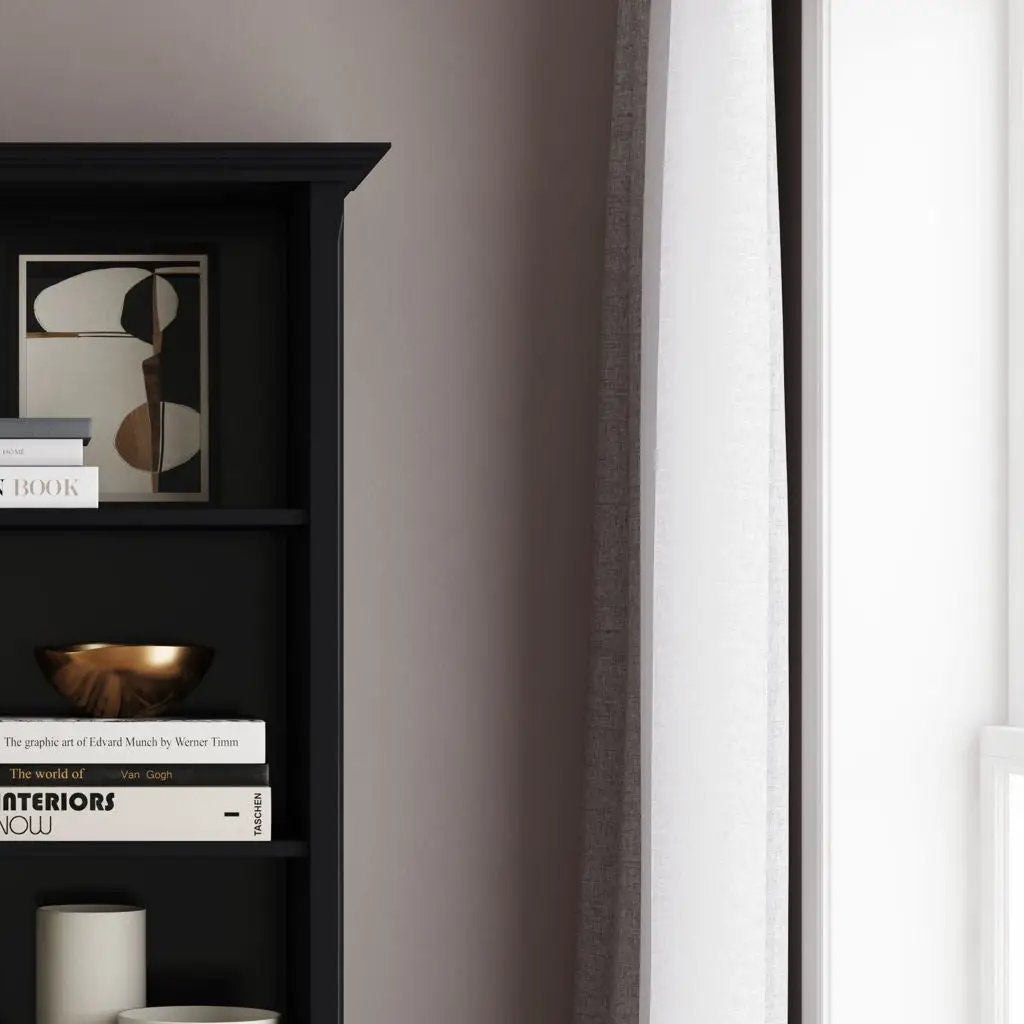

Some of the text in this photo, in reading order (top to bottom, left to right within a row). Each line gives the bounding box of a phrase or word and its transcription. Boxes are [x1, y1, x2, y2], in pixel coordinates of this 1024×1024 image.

[14, 478, 79, 496] BOOK
[4, 736, 239, 750] The graphic art of Edvard Munch by Werner Timm
[10, 767, 85, 779] The world of
[121, 770, 173, 780] Van Gogh
[254, 793, 263, 836] TASCHEN
